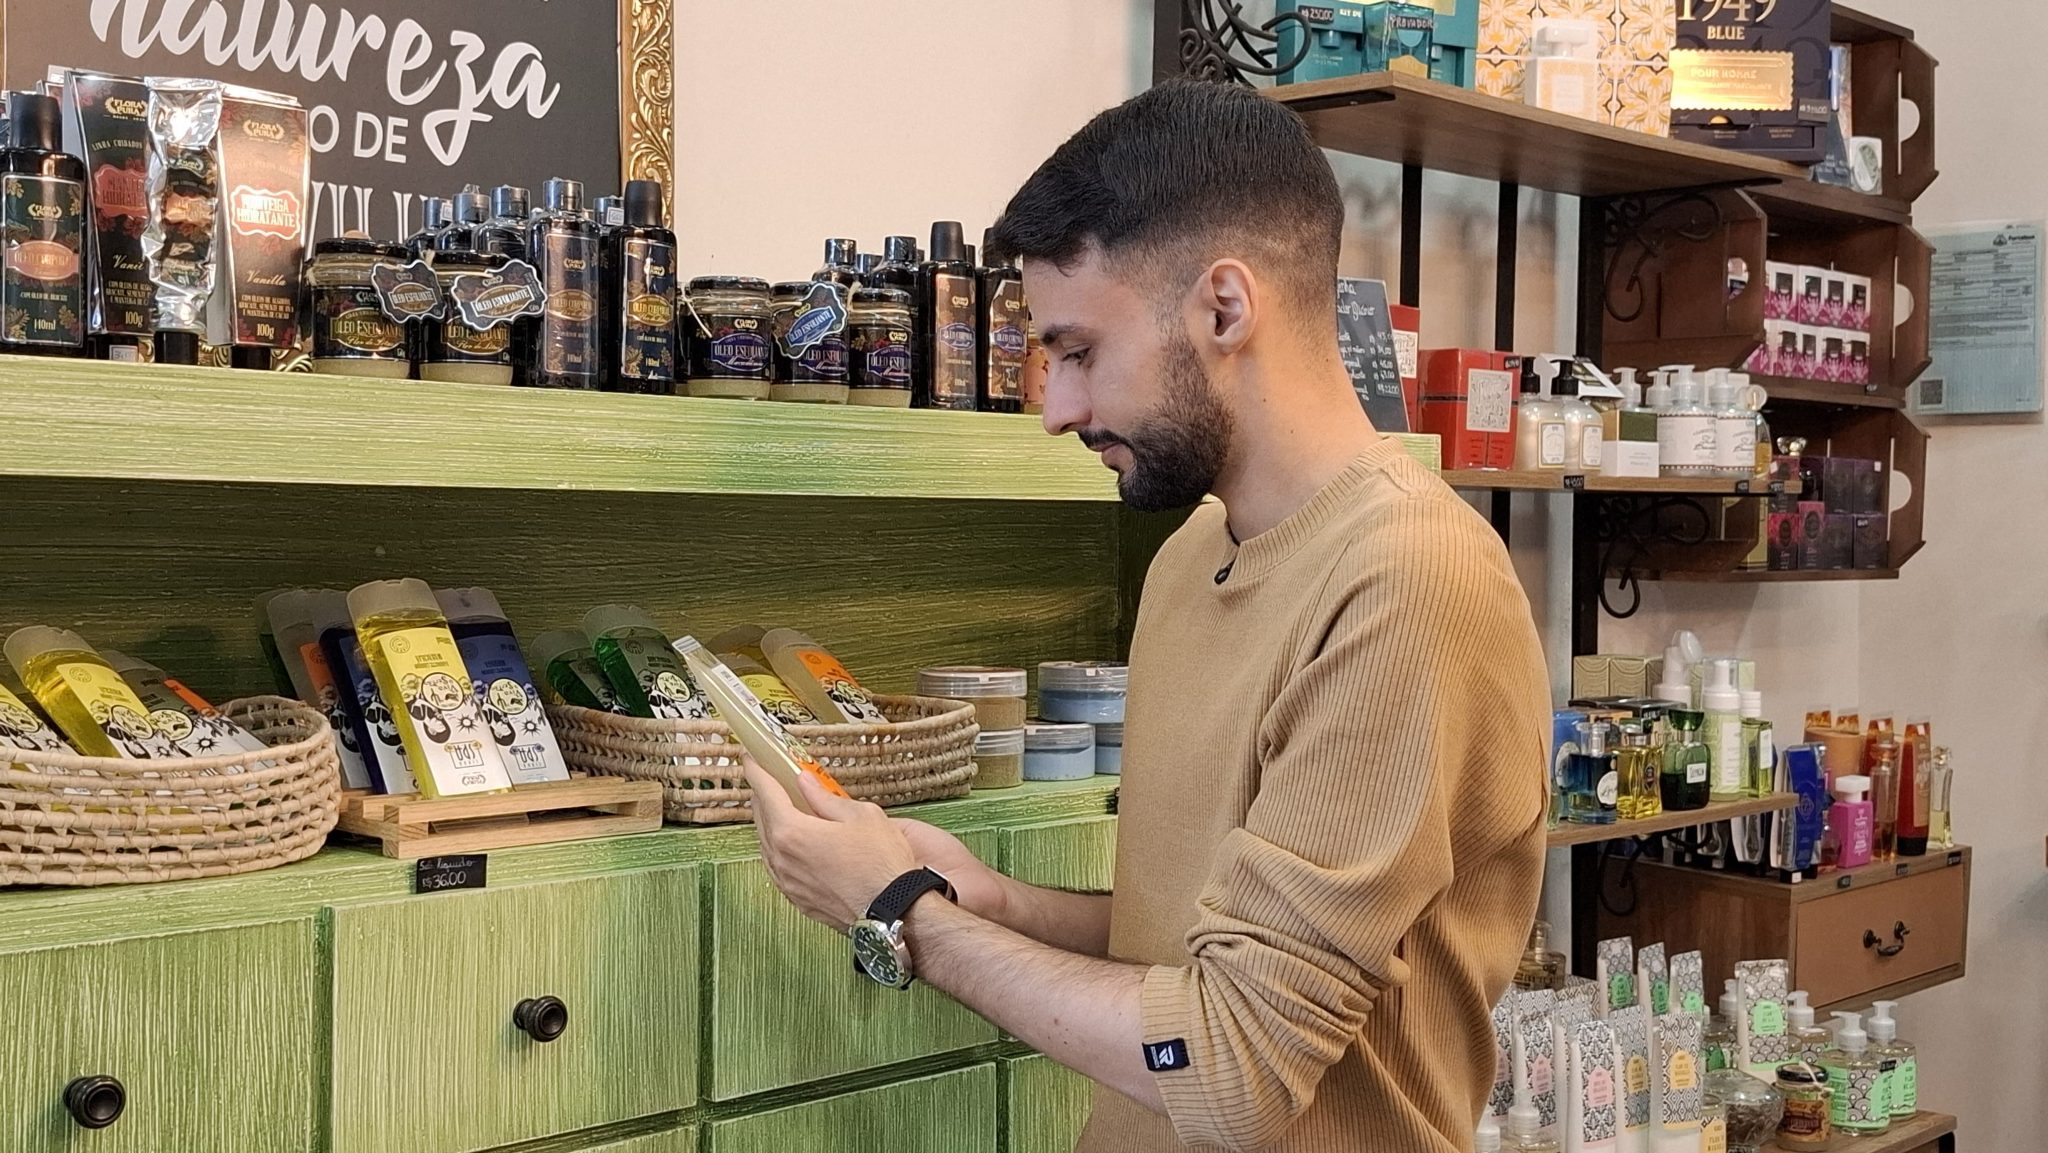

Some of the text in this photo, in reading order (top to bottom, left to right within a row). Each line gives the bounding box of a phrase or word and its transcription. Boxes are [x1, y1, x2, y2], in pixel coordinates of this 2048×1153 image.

[1707, 25, 1745, 40] BLUE
[1690, 68, 1719, 79] POUR
[89, 0, 560, 166] natureza
[115, 98, 142, 108] FLORA
[117, 106, 140, 116] PURA
[251, 121, 277, 131] FLORA
[252, 128, 275, 138] PURA
[354, 111, 408, 164] DE
[241, 193, 289, 213] MANTEIGA
[236, 207, 296, 228] HIDRATANTE
[247, 270, 286, 286] Vanilla
[125, 311, 144, 328] 100g
[256, 323, 275, 340] 100g
[453, 744, 474, 760] SPA
